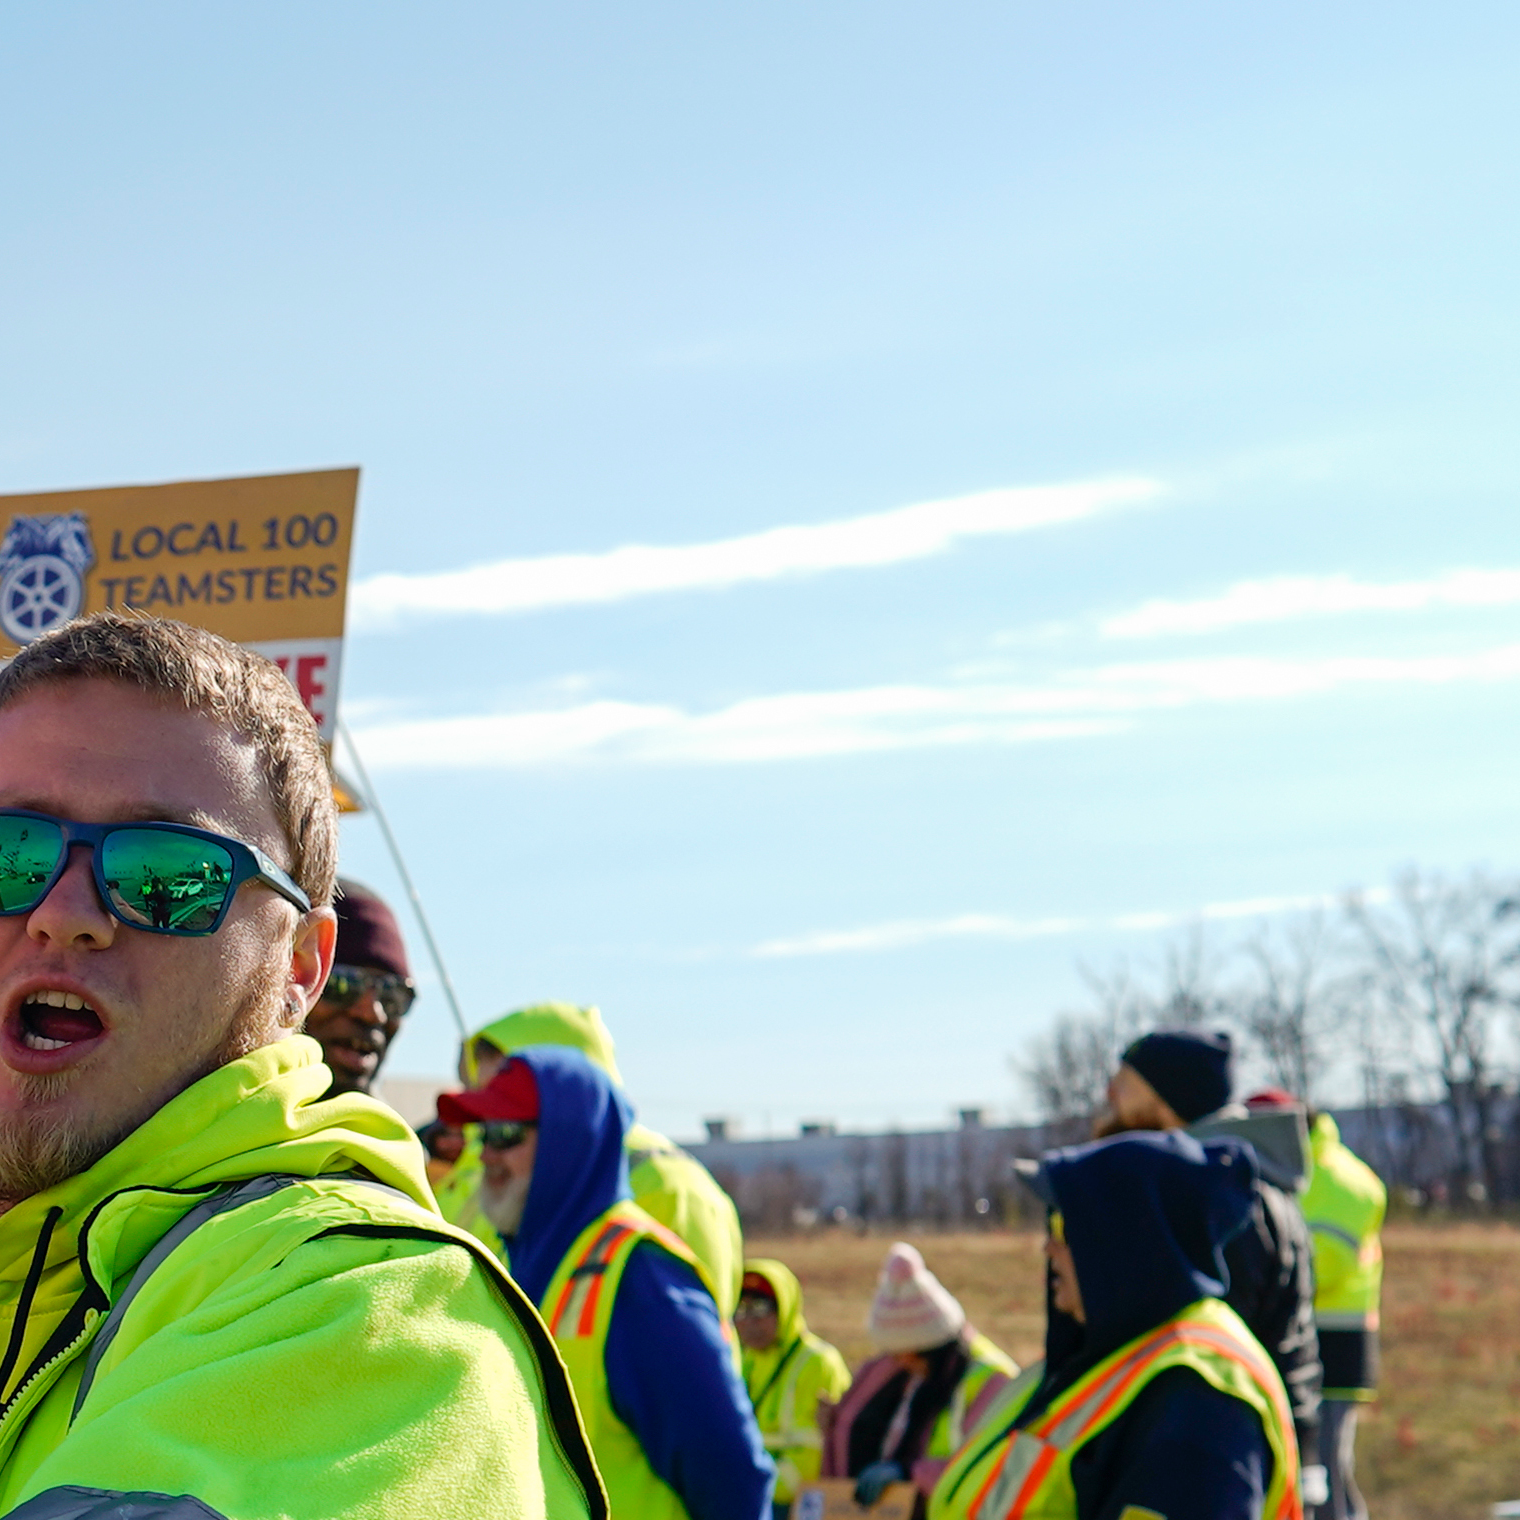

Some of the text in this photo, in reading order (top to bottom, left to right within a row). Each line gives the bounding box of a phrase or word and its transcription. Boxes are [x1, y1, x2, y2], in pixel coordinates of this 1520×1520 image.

[111, 511, 338, 561] LOCAL 100
[99, 563, 338, 609] TEAMSTERS
